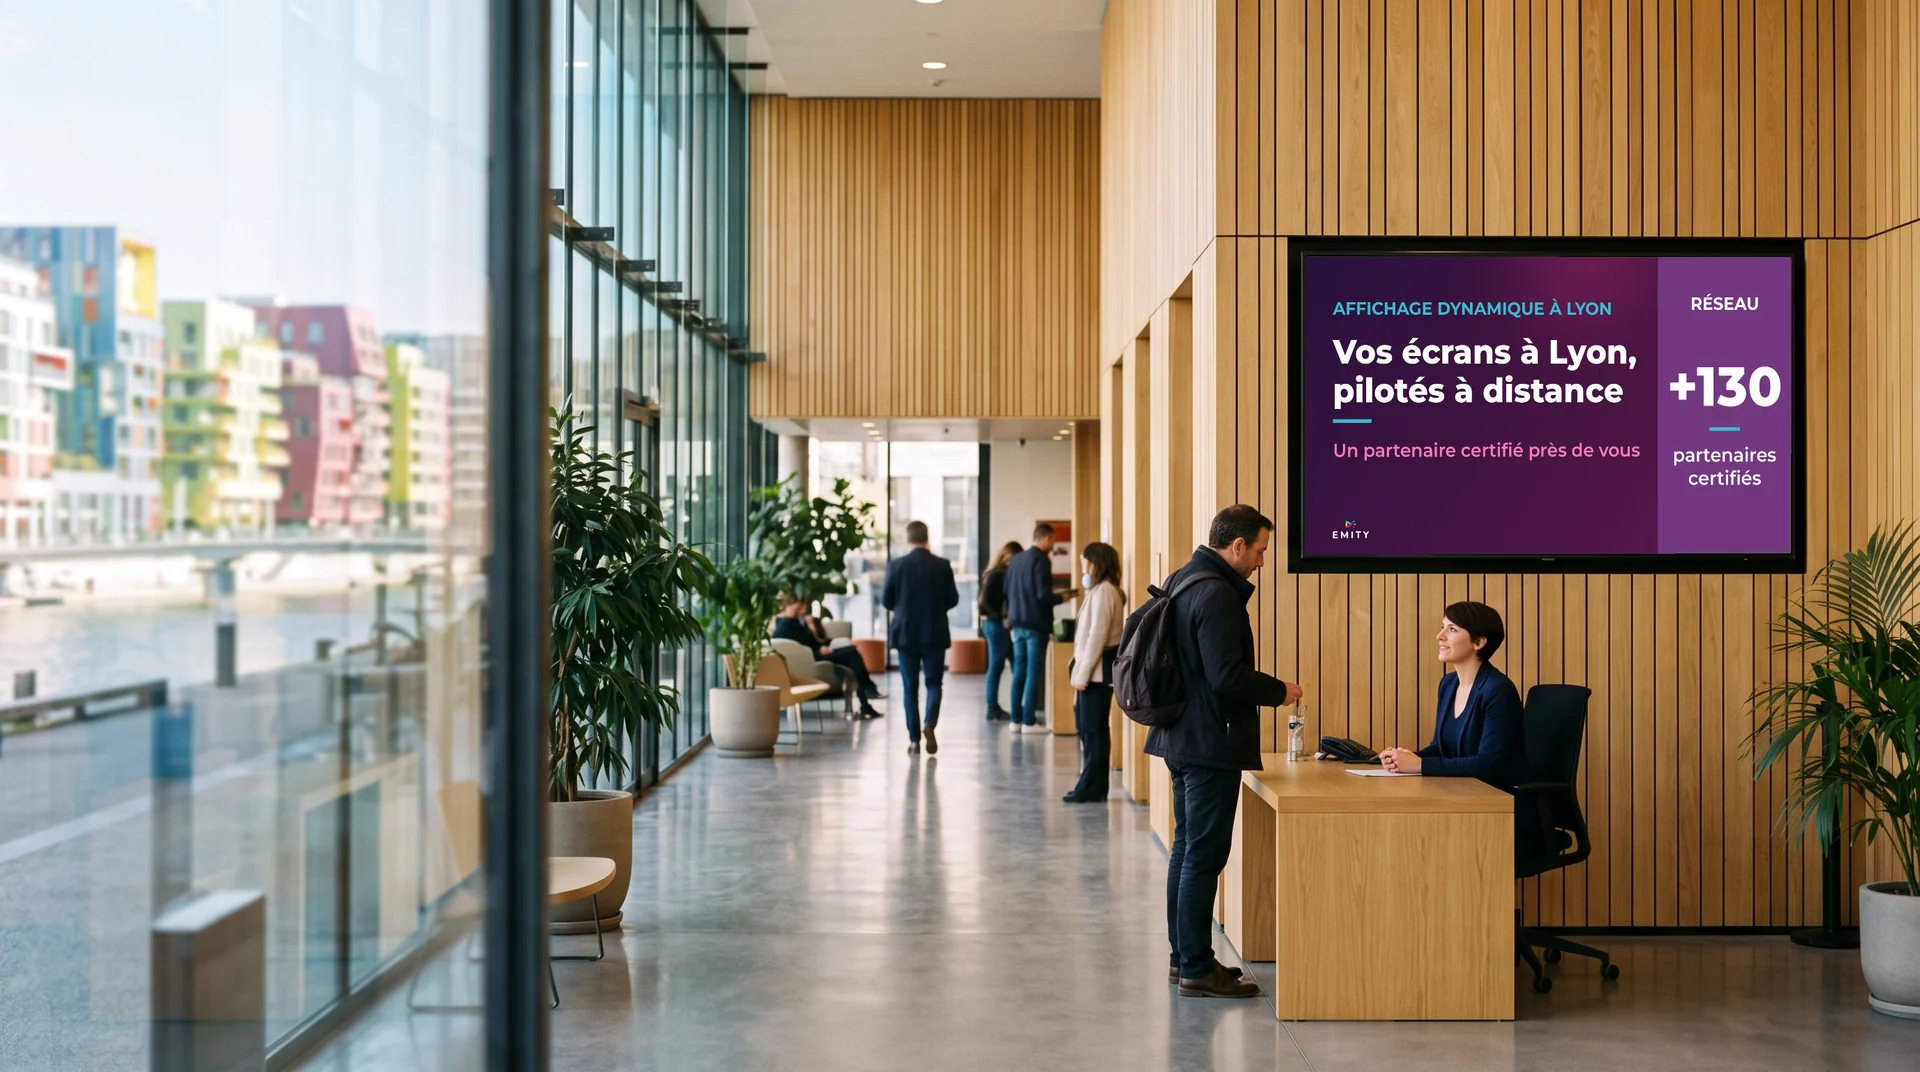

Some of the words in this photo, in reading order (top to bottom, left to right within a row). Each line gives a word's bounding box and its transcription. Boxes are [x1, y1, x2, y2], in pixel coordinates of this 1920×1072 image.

[1332, 301, 1433, 316] AFFICHAGE
[1437, 301, 1545, 319] DYNAMIQUE
[1549, 298, 1563, 316] À
[1567, 301, 1612, 316] LYON
[1691, 293, 1759, 311] RÉSEAU
[1332, 339, 1393, 365] Vos
[1401, 337, 1512, 365] écrans
[1520, 337, 1539, 365] à
[1550, 339, 1637, 371] Lyon,
[1333, 374, 1445, 410] pilotés
[1454, 376, 1473, 404] à
[1482, 374, 1624, 404] distance
[1669, 365, 1782, 408] +130
[1333, 443, 1358, 458] Un
[1364, 442, 1456, 462] partenaire
[1460, 441, 1524, 458] certifié
[1529, 442, 1567, 461] près
[1571, 442, 1595, 458] de
[1599, 445, 1641, 458] vous
[1673, 446, 1777, 466] partenaires
[1688, 469, 1762, 486] certifiés
[1332, 530, 1370, 539] EMITY
